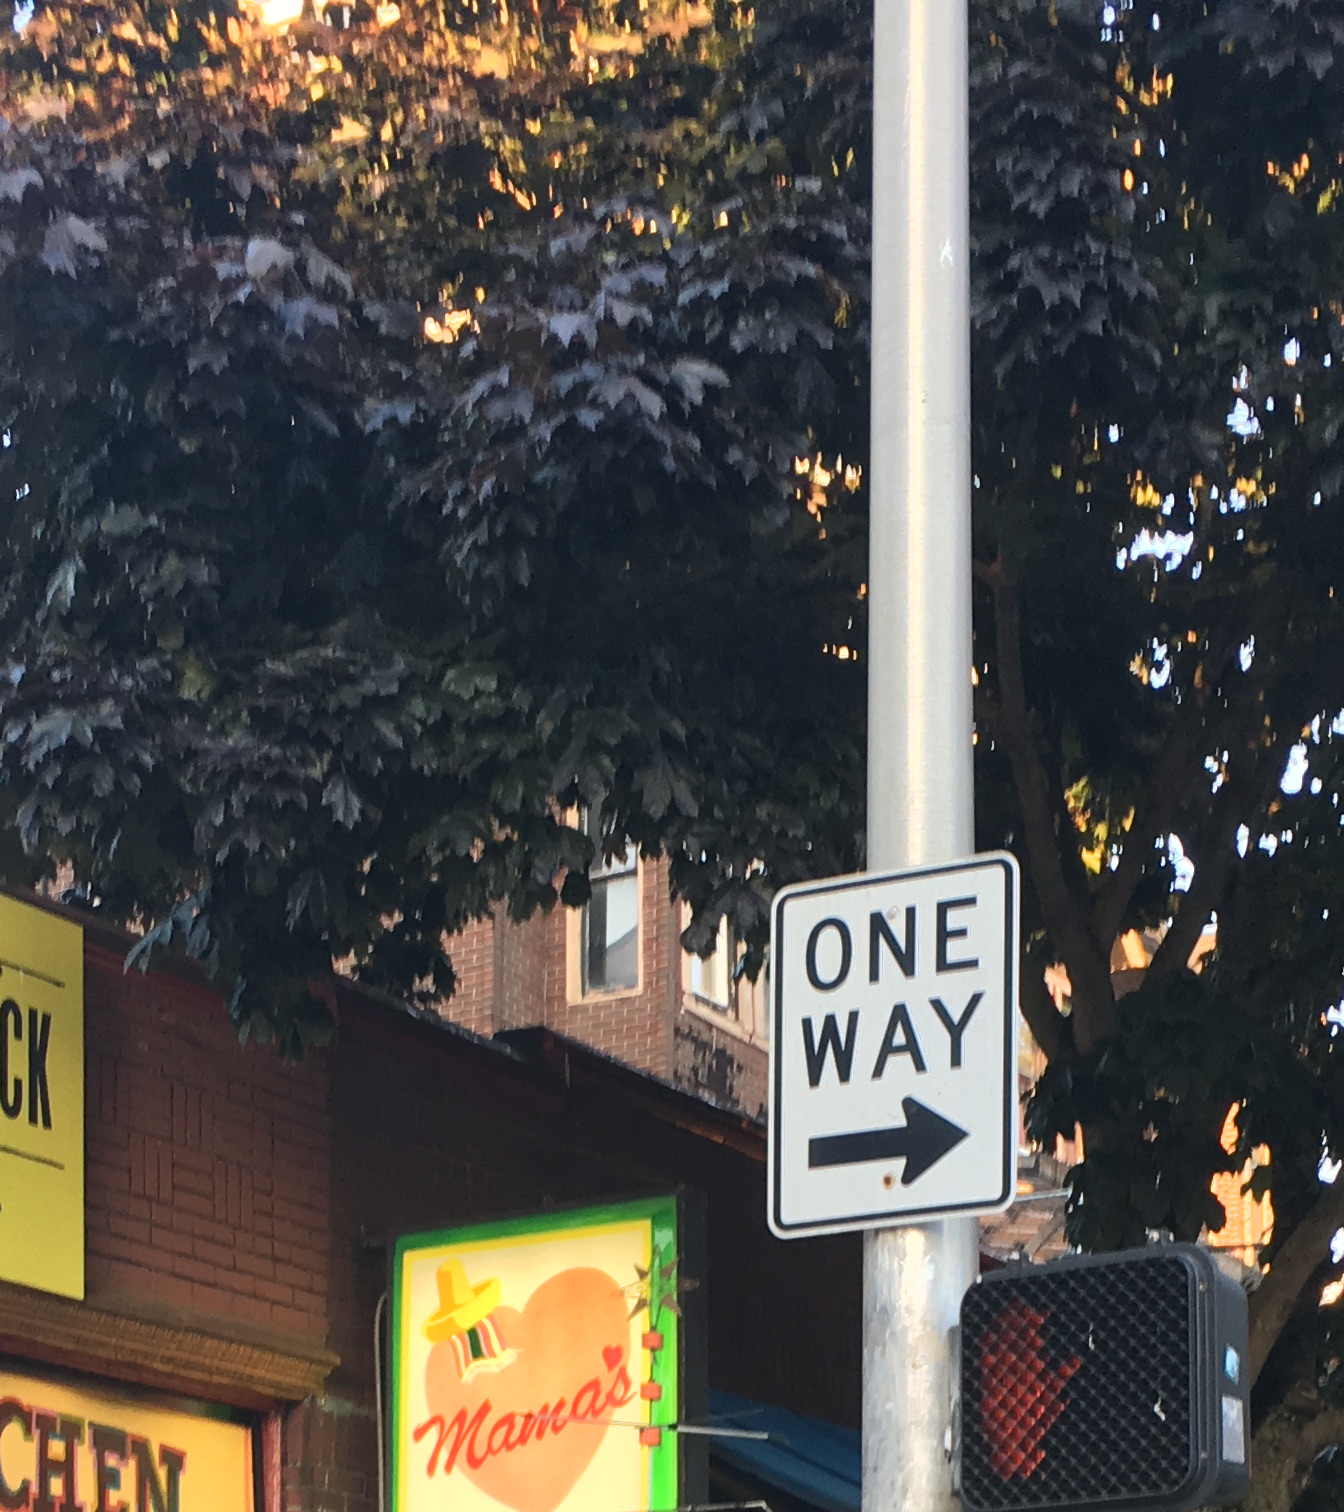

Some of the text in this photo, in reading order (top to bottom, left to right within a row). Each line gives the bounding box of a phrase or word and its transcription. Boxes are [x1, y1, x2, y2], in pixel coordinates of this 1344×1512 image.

[803, 893, 980, 993] ONE
[800, 988, 987, 1091] WAY
[412, 1344, 637, 1479] Mama's
